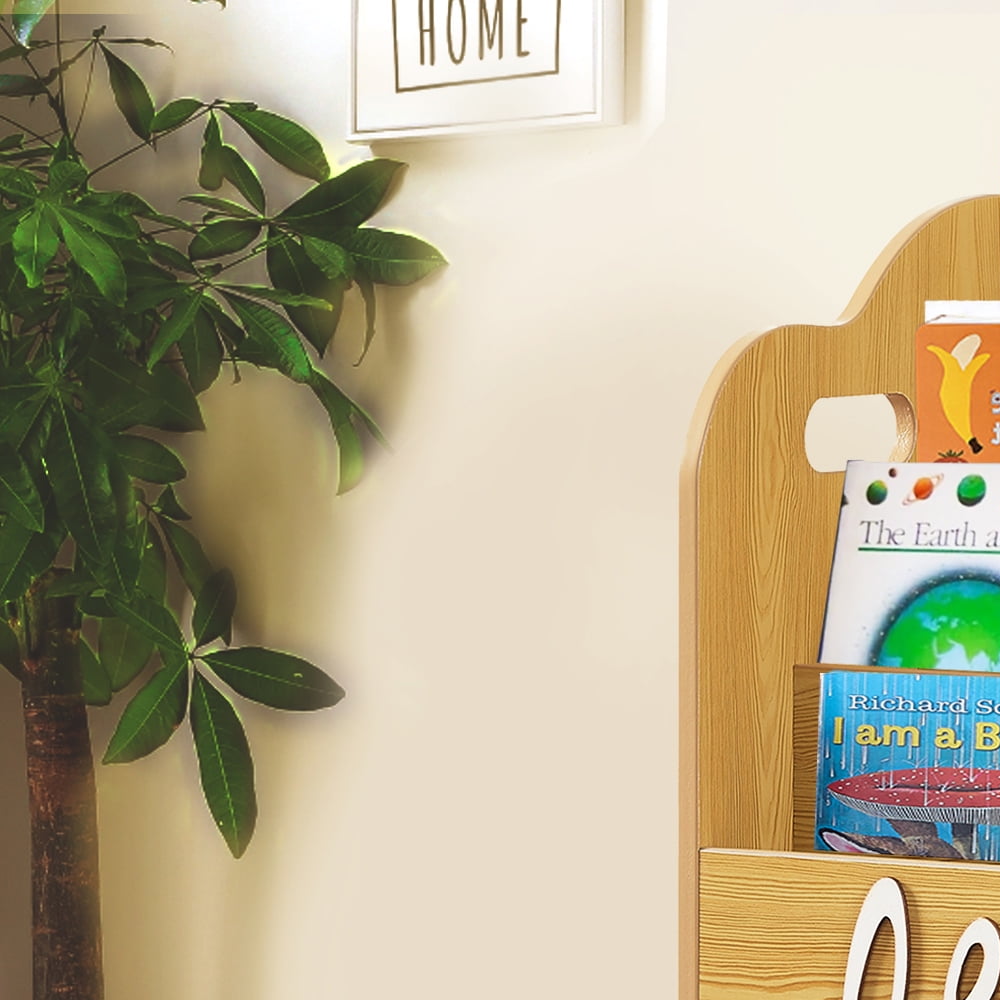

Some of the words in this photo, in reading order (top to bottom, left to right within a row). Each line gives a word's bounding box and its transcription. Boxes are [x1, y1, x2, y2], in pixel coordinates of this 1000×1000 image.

[418, 0, 530, 66] HOME
[859, 519, 906, 546] The
[915, 522, 977, 548] Earth
[848, 694, 968, 714] Richard
[832, 716, 844, 745] I
[854, 724, 920, 748] am
[934, 726, 963, 750] a
